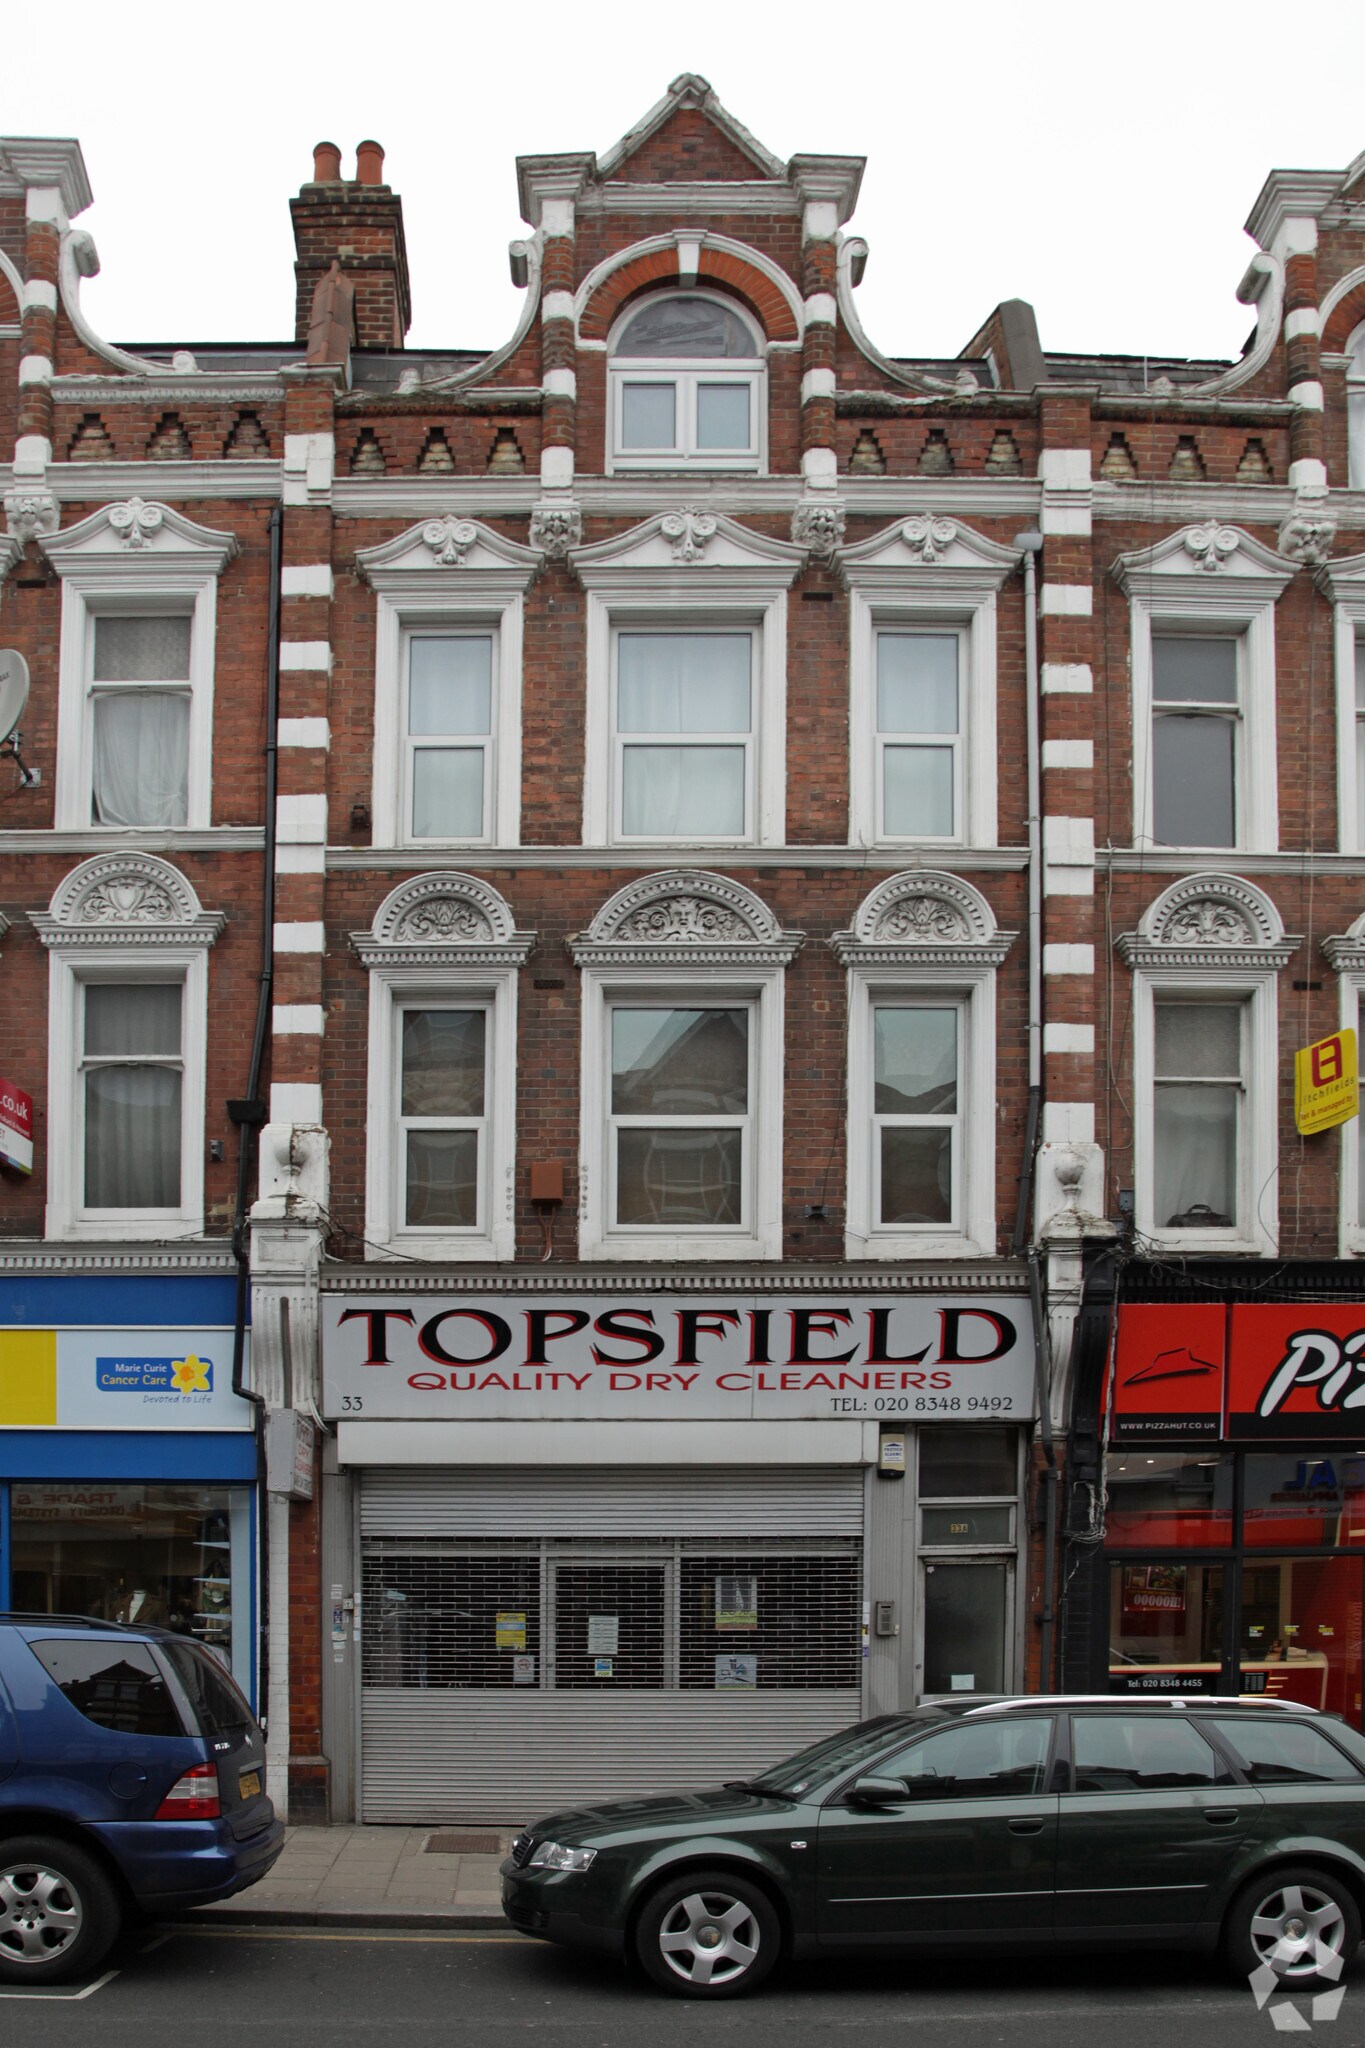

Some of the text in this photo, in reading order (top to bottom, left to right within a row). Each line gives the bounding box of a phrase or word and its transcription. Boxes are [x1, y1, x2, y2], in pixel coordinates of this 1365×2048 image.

[337, 1308, 1017, 1367] TOPSFIELD
[115, 1363, 167, 1373] Marie Curie
[101, 1374, 167, 1386] Cancer Care
[407, 1372, 951, 1391] QUALITY DRY CLEANERS
[143, 1394, 212, 1404] Devoted to Life
[342, 1397, 362, 1410] 33
[831, 1397, 1012, 1411] TEL: 020 8348 9492
[1120, 1422, 1216, 1430] WWW.PIZZAHUT.CO.UK
[1127, 1679, 1202, 1688] Tel: 020 8348 4455
